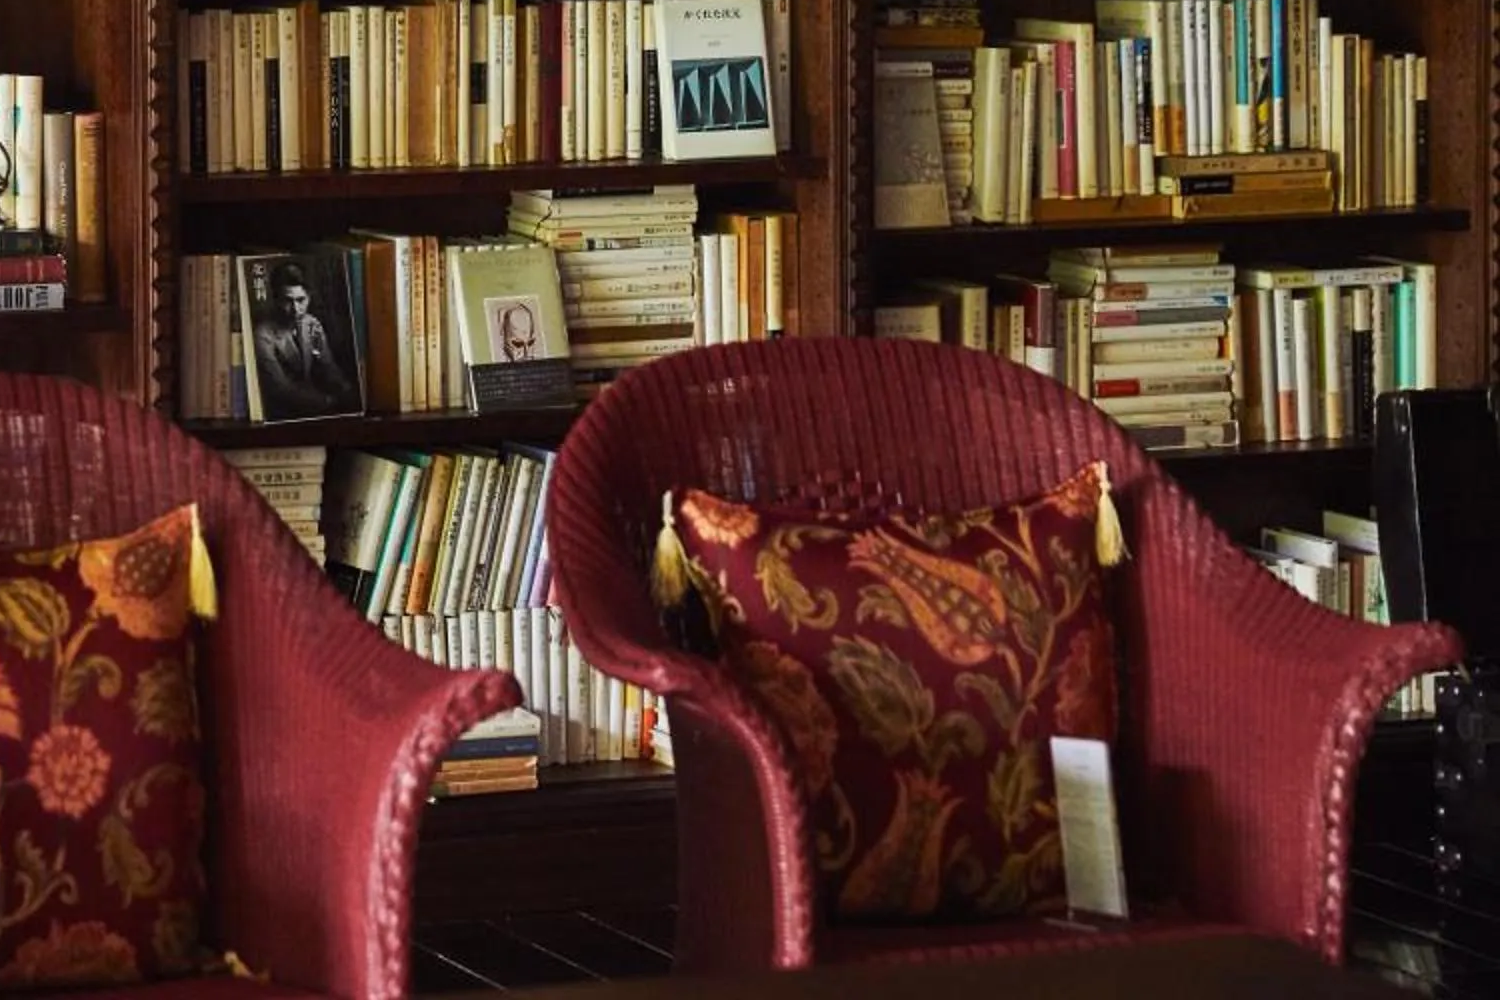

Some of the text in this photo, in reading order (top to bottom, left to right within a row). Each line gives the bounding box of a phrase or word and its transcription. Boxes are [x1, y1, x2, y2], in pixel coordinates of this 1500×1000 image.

[683, 7, 742, 20] かくれた次元
